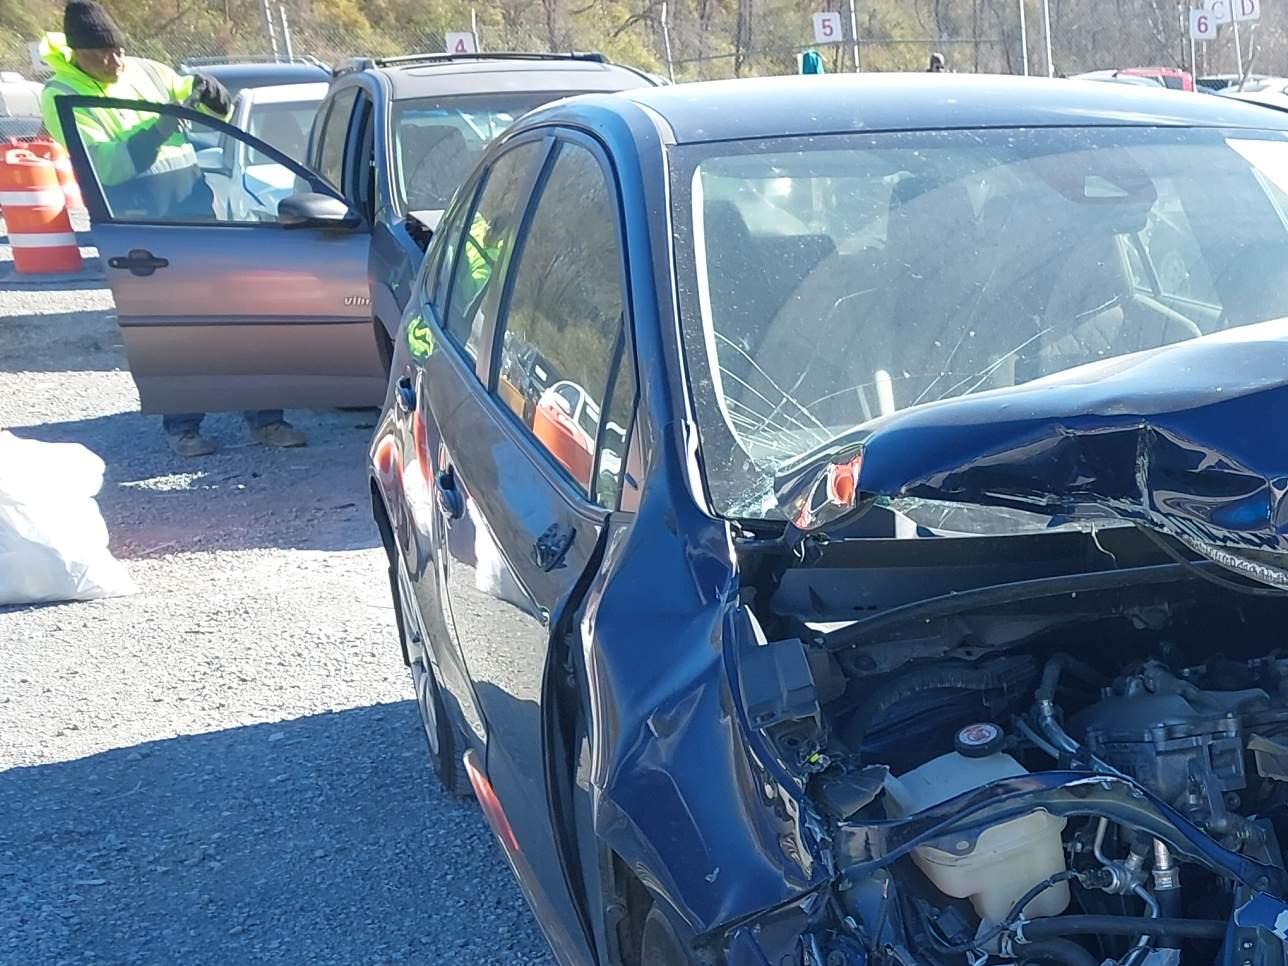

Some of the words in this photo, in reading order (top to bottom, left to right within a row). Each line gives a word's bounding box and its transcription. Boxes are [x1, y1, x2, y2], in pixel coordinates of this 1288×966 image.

[1241, 0, 1255, 16] D
[822, 18, 833, 37] 5
[1197, 15, 1208, 33] 6
[455, 38, 467, 53] 4
